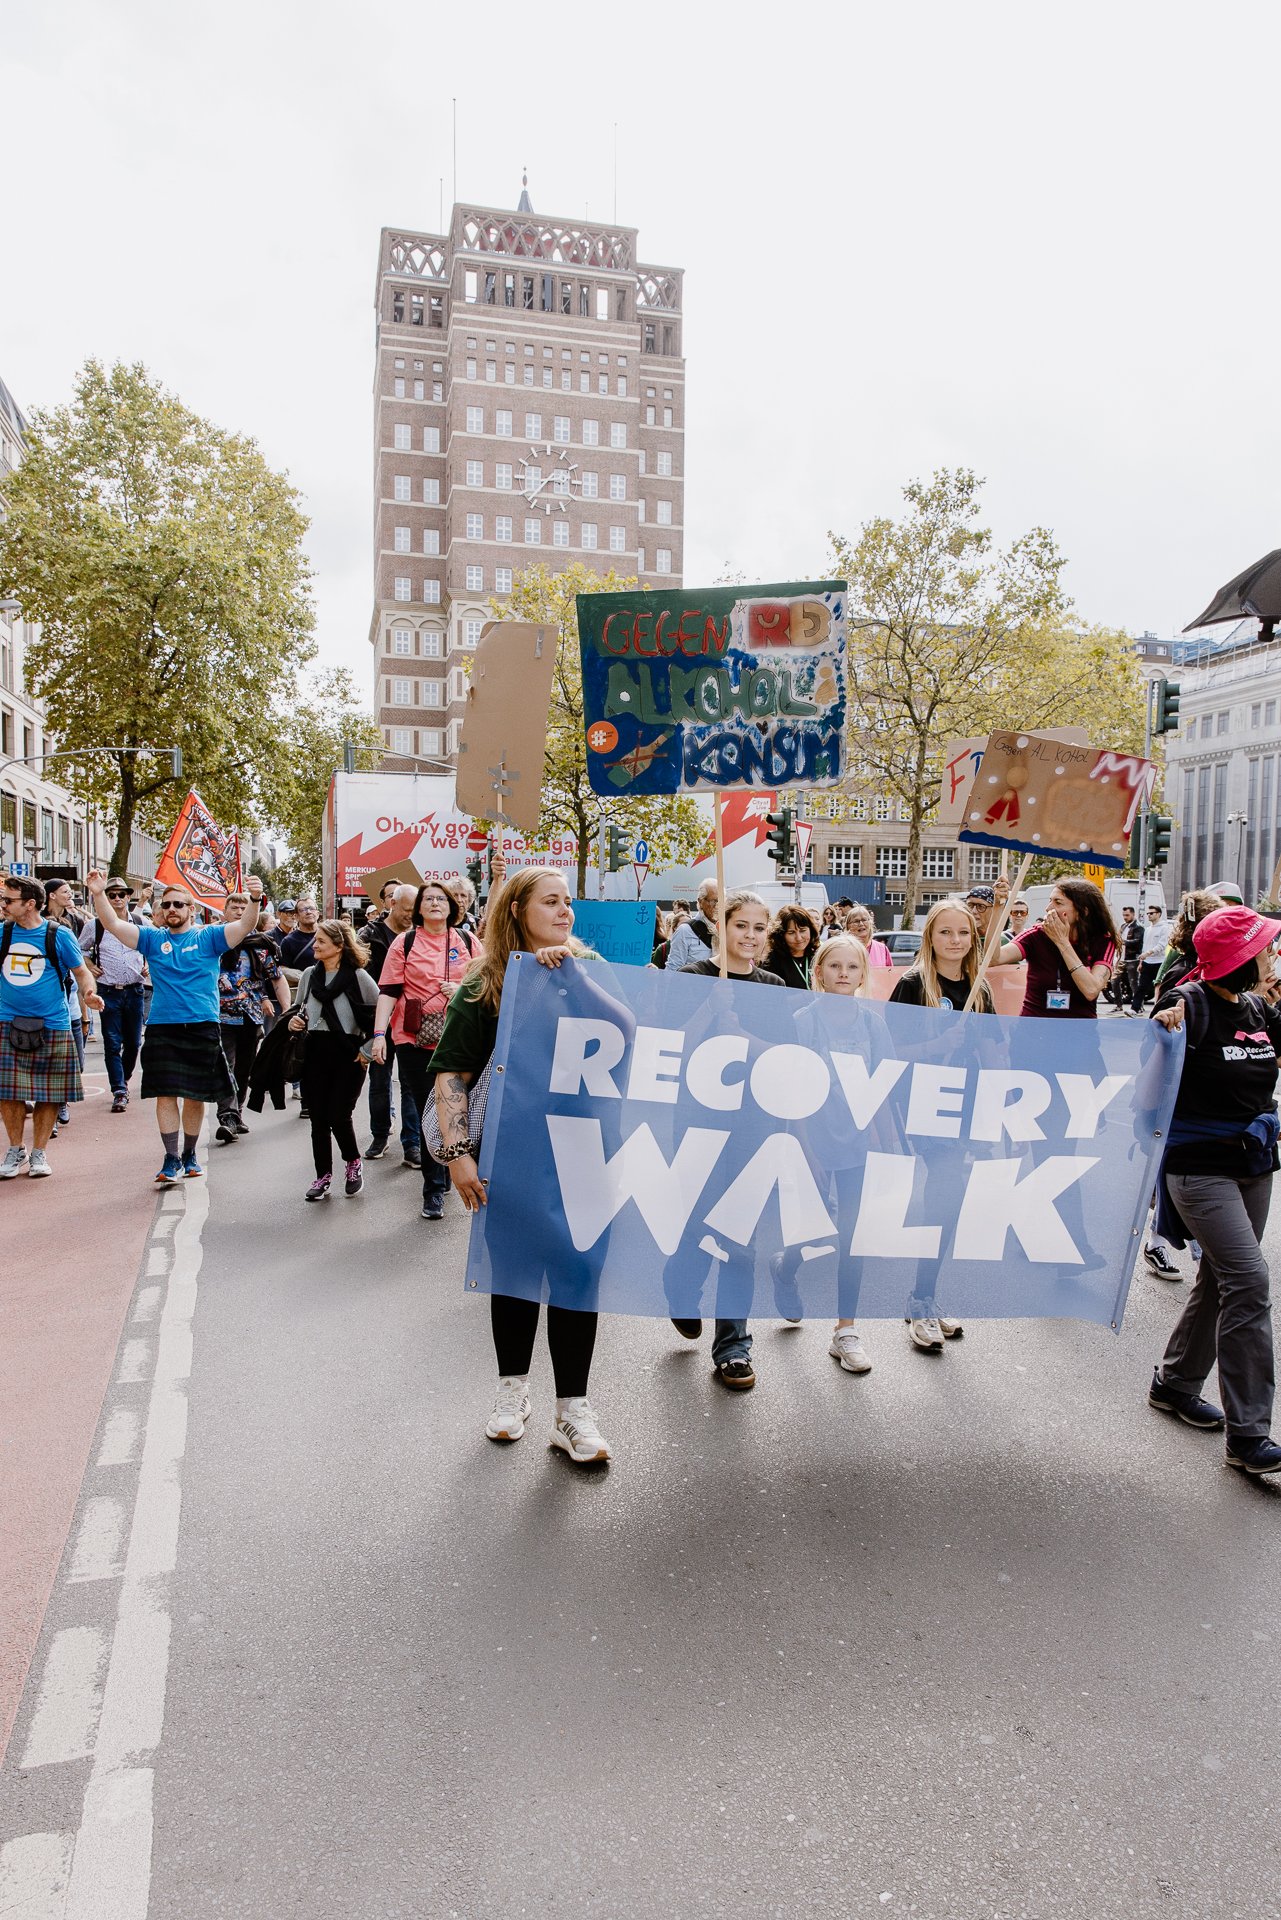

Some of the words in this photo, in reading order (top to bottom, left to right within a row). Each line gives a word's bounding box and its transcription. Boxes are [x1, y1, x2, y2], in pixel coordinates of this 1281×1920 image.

[602, 610, 728, 656] GEGEN
[603, 661, 818, 724] ALKOHOL
[683, 726, 840, 787] KONSUM
[994, 736, 1022, 756] Gegen
[376, 817, 404, 833] Oh
[524, 856, 547, 867] and
[1089, 865, 1101, 876] U1
[547, 1016, 1133, 1143] RECOVERY
[545, 1114, 1099, 1264] WALK
